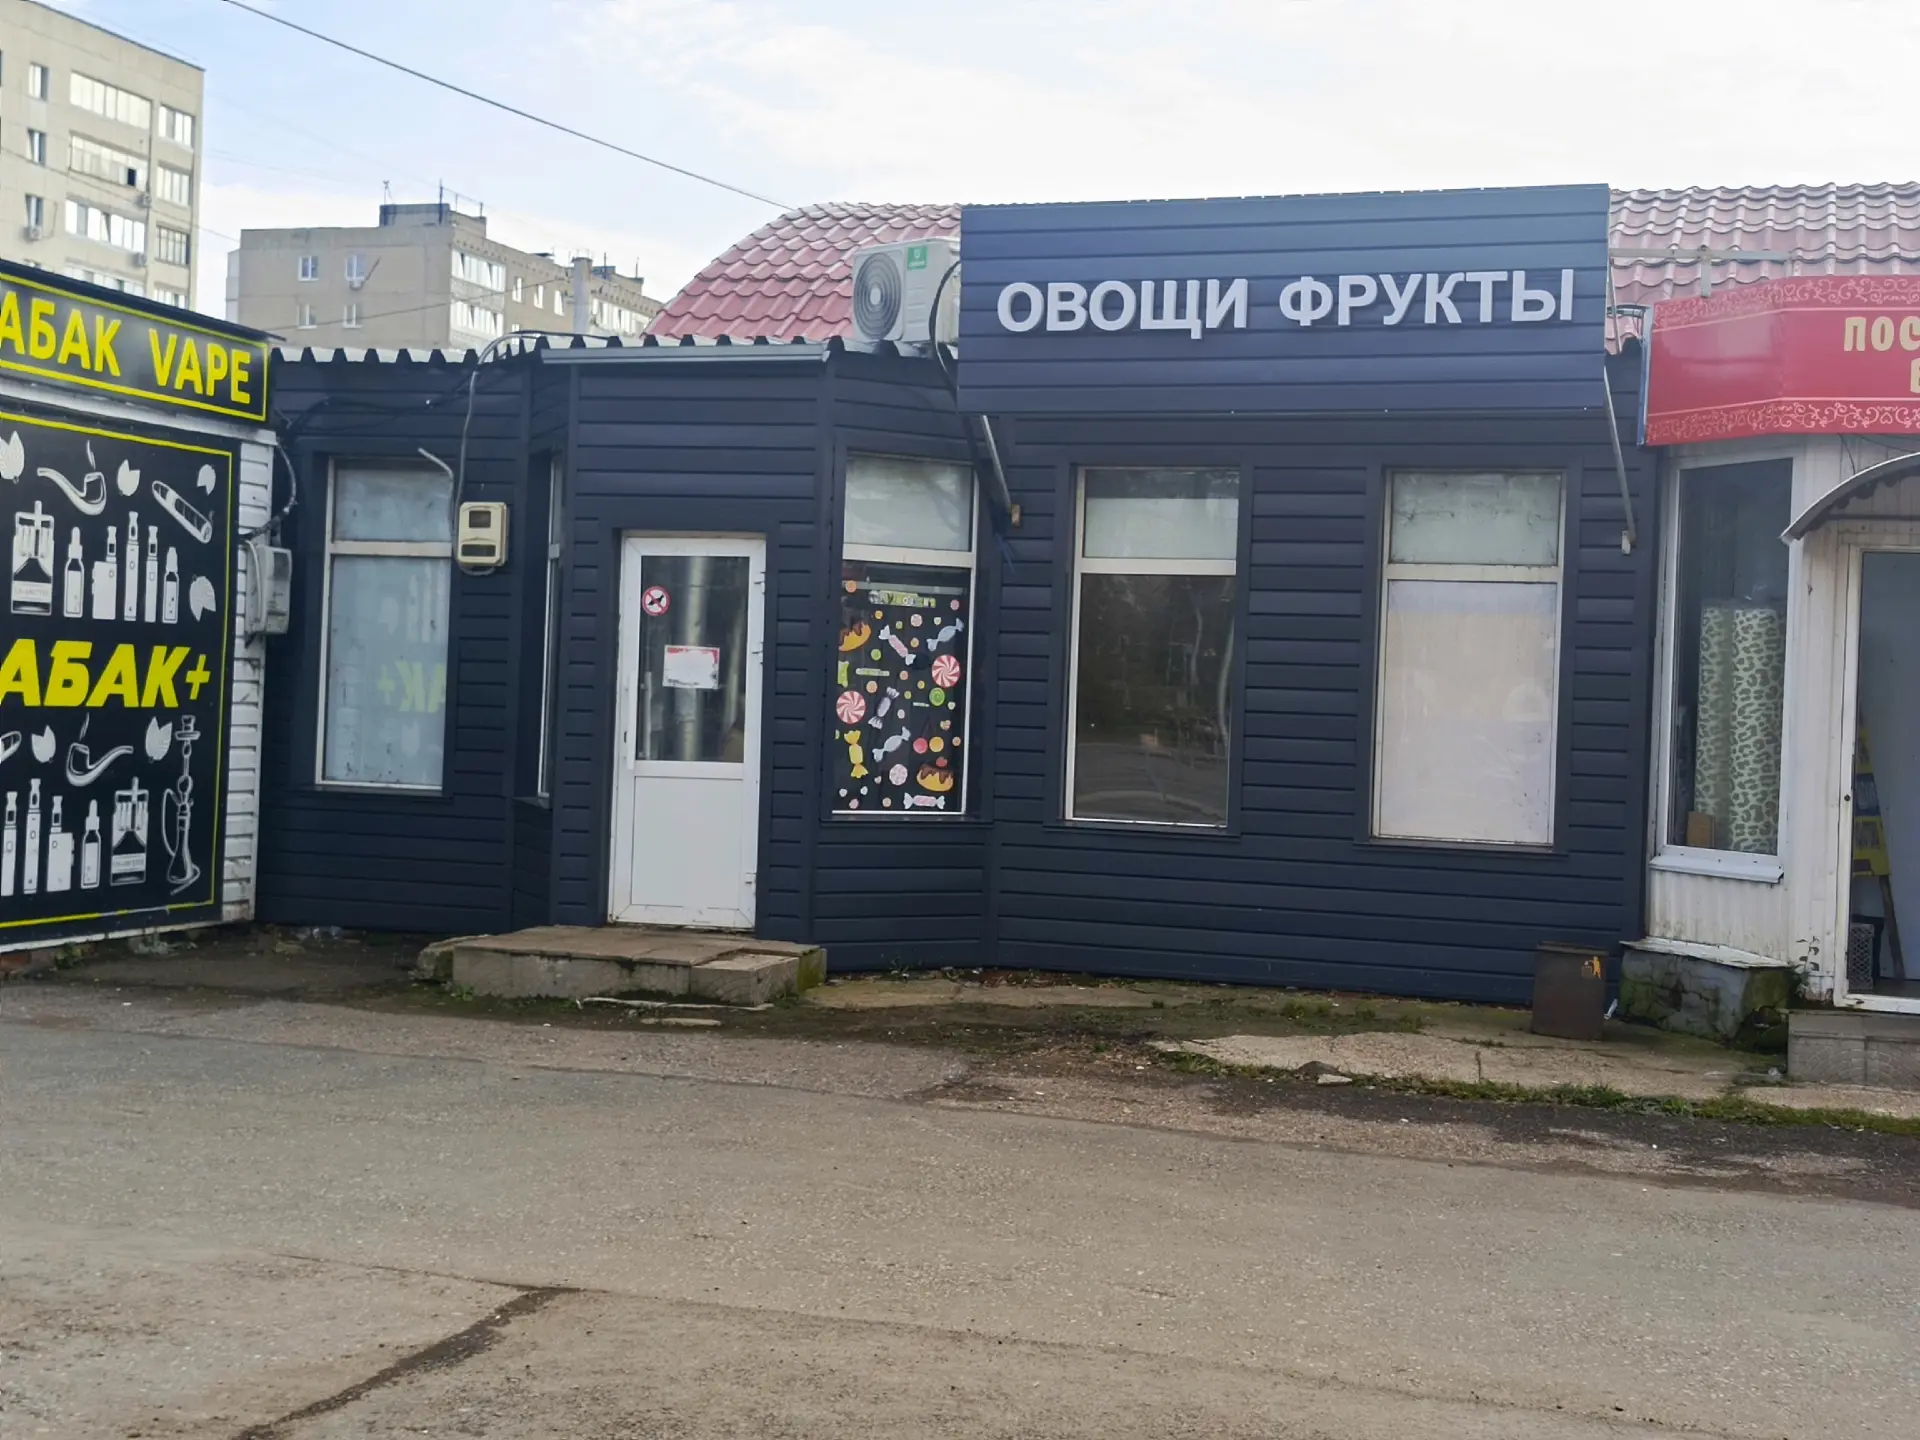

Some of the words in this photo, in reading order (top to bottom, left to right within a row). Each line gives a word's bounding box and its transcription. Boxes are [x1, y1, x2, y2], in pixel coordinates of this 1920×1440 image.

[997, 278, 1248, 339] ОВОЩИ
[1279, 268, 1575, 327] ФРУКТЫ
[149, 327, 251, 404] VAPE
